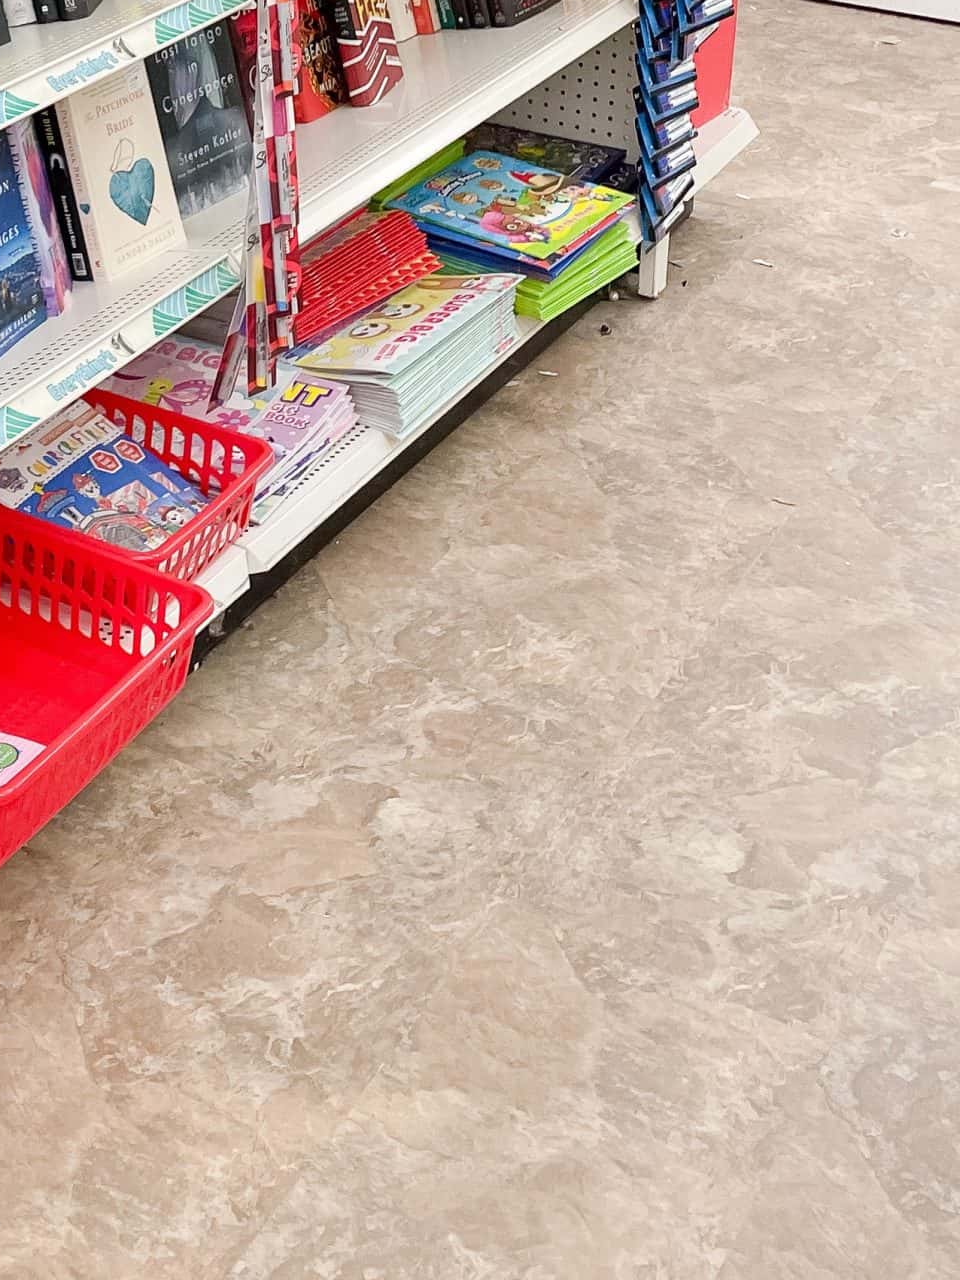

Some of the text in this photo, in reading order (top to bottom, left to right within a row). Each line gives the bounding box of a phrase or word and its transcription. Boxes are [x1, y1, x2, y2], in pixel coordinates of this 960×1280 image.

[162, 72, 234, 113] Cyberspace
[105, 118, 135, 136] BRIDE
[177, 128, 242, 166] Steven Kotler
[264, 411, 310, 430] BOOK
